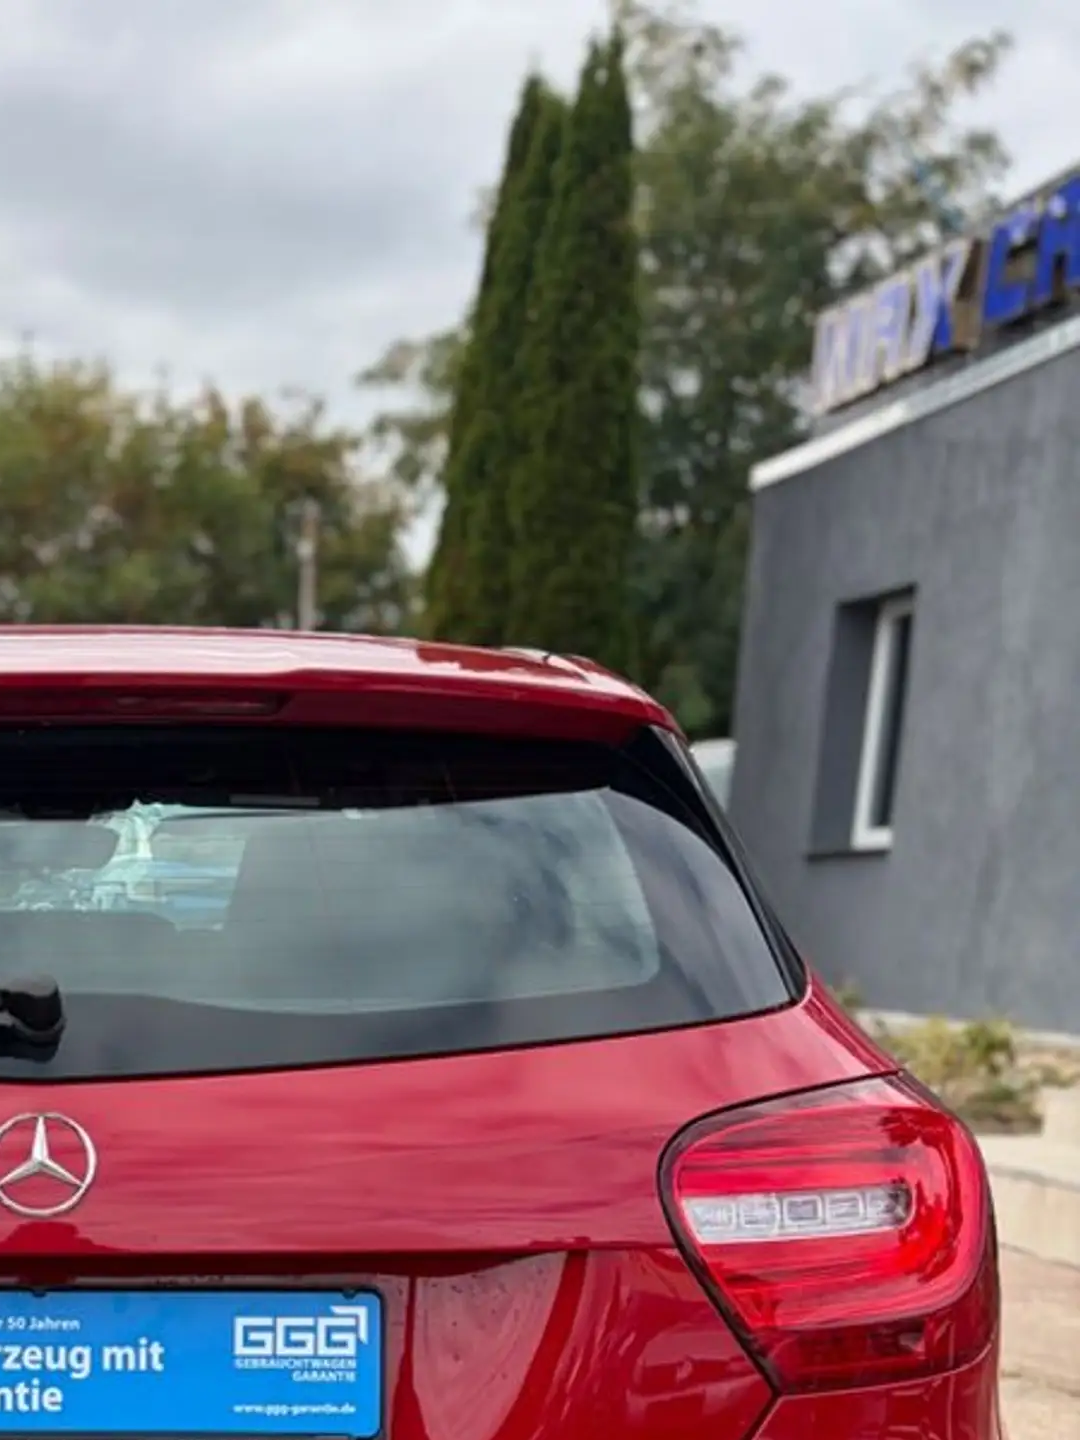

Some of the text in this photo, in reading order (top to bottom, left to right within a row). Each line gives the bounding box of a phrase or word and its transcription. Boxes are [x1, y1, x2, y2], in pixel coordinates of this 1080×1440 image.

[7, 1316, 24, 1330] 50
[28, 1316, 81, 1331] Jahren
[233, 1316, 357, 1356] GGG
[102, 1336, 165, 1372] mit
[234, 1357, 357, 1369] GEBRAUCHTWAGEN
[292, 1370, 356, 1382] GARANTIE
[233, 1402, 357, 1417] www.ggg-garantie.de
